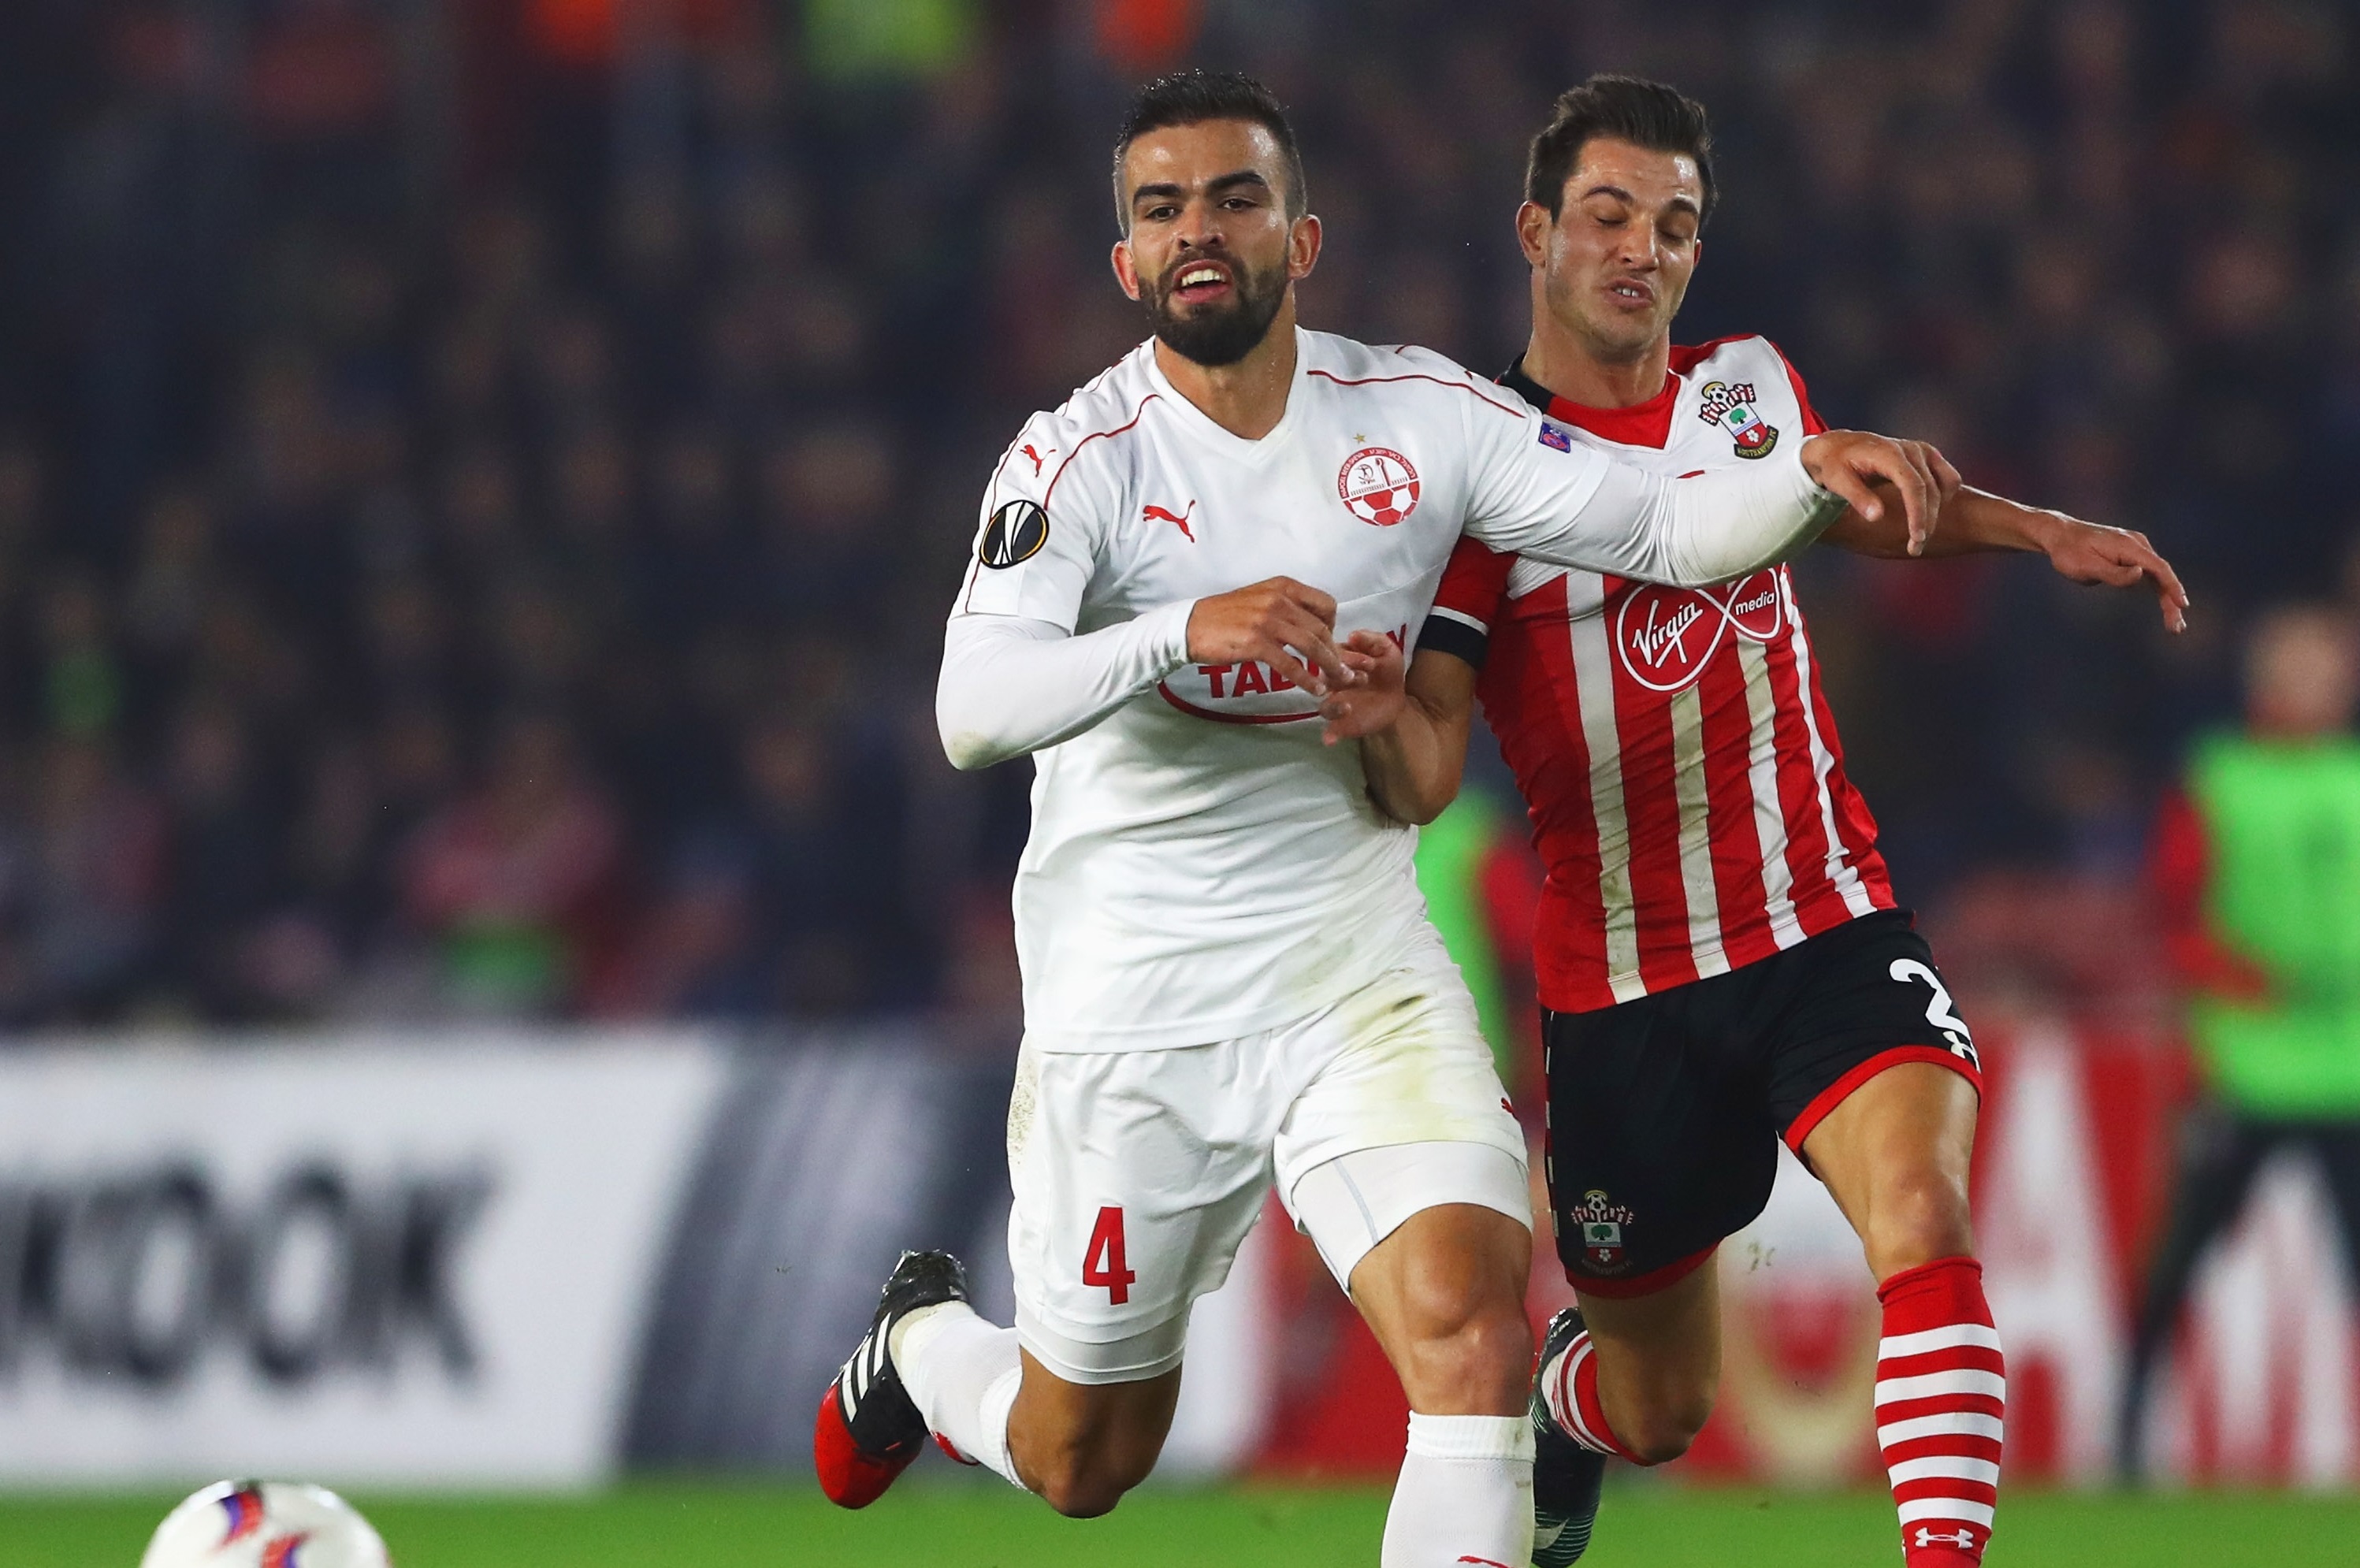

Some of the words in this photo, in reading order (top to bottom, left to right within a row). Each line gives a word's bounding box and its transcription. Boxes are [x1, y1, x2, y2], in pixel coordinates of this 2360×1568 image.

[1632, 599, 1704, 669] Virgin
[1735, 591, 1775, 615] media
[1083, 1206, 1135, 1306] 4
